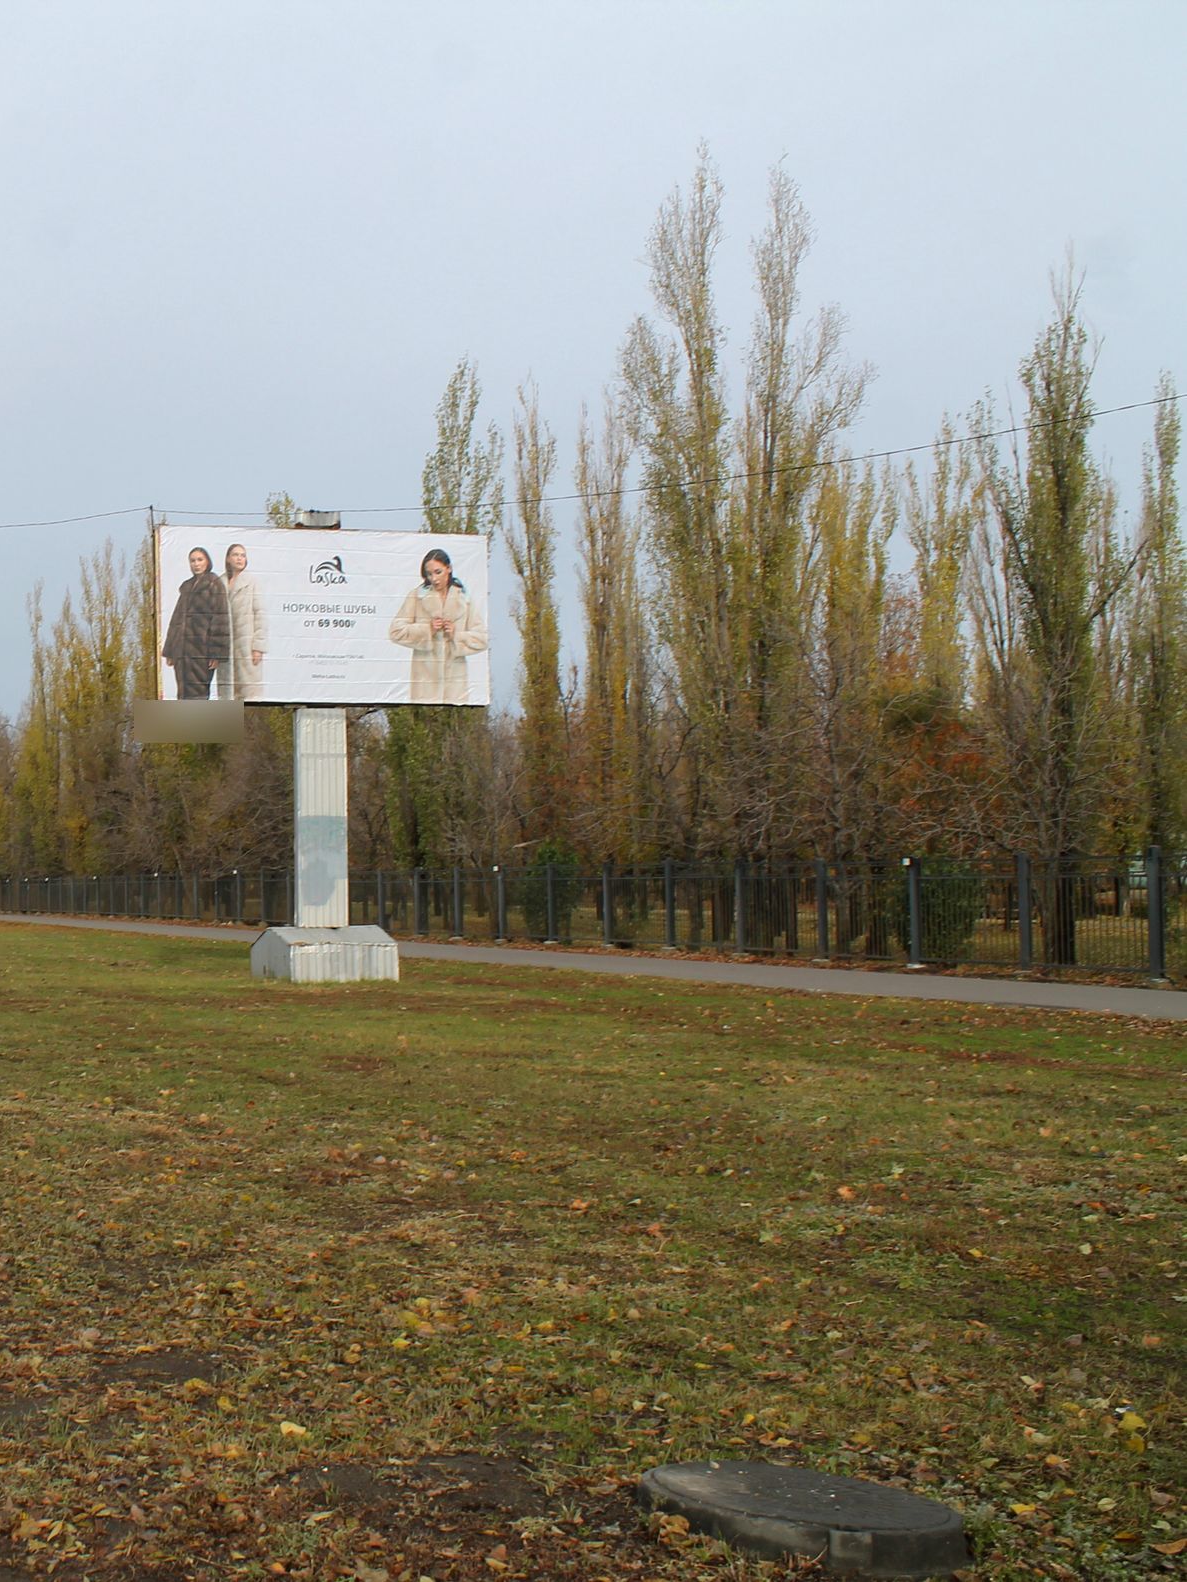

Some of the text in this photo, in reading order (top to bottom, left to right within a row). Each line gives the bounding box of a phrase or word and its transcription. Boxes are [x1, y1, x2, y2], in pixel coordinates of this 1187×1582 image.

[282, 603, 376, 614] НОРКОВЫЕ ШУБЫ
[317, 618, 330, 628] 69
